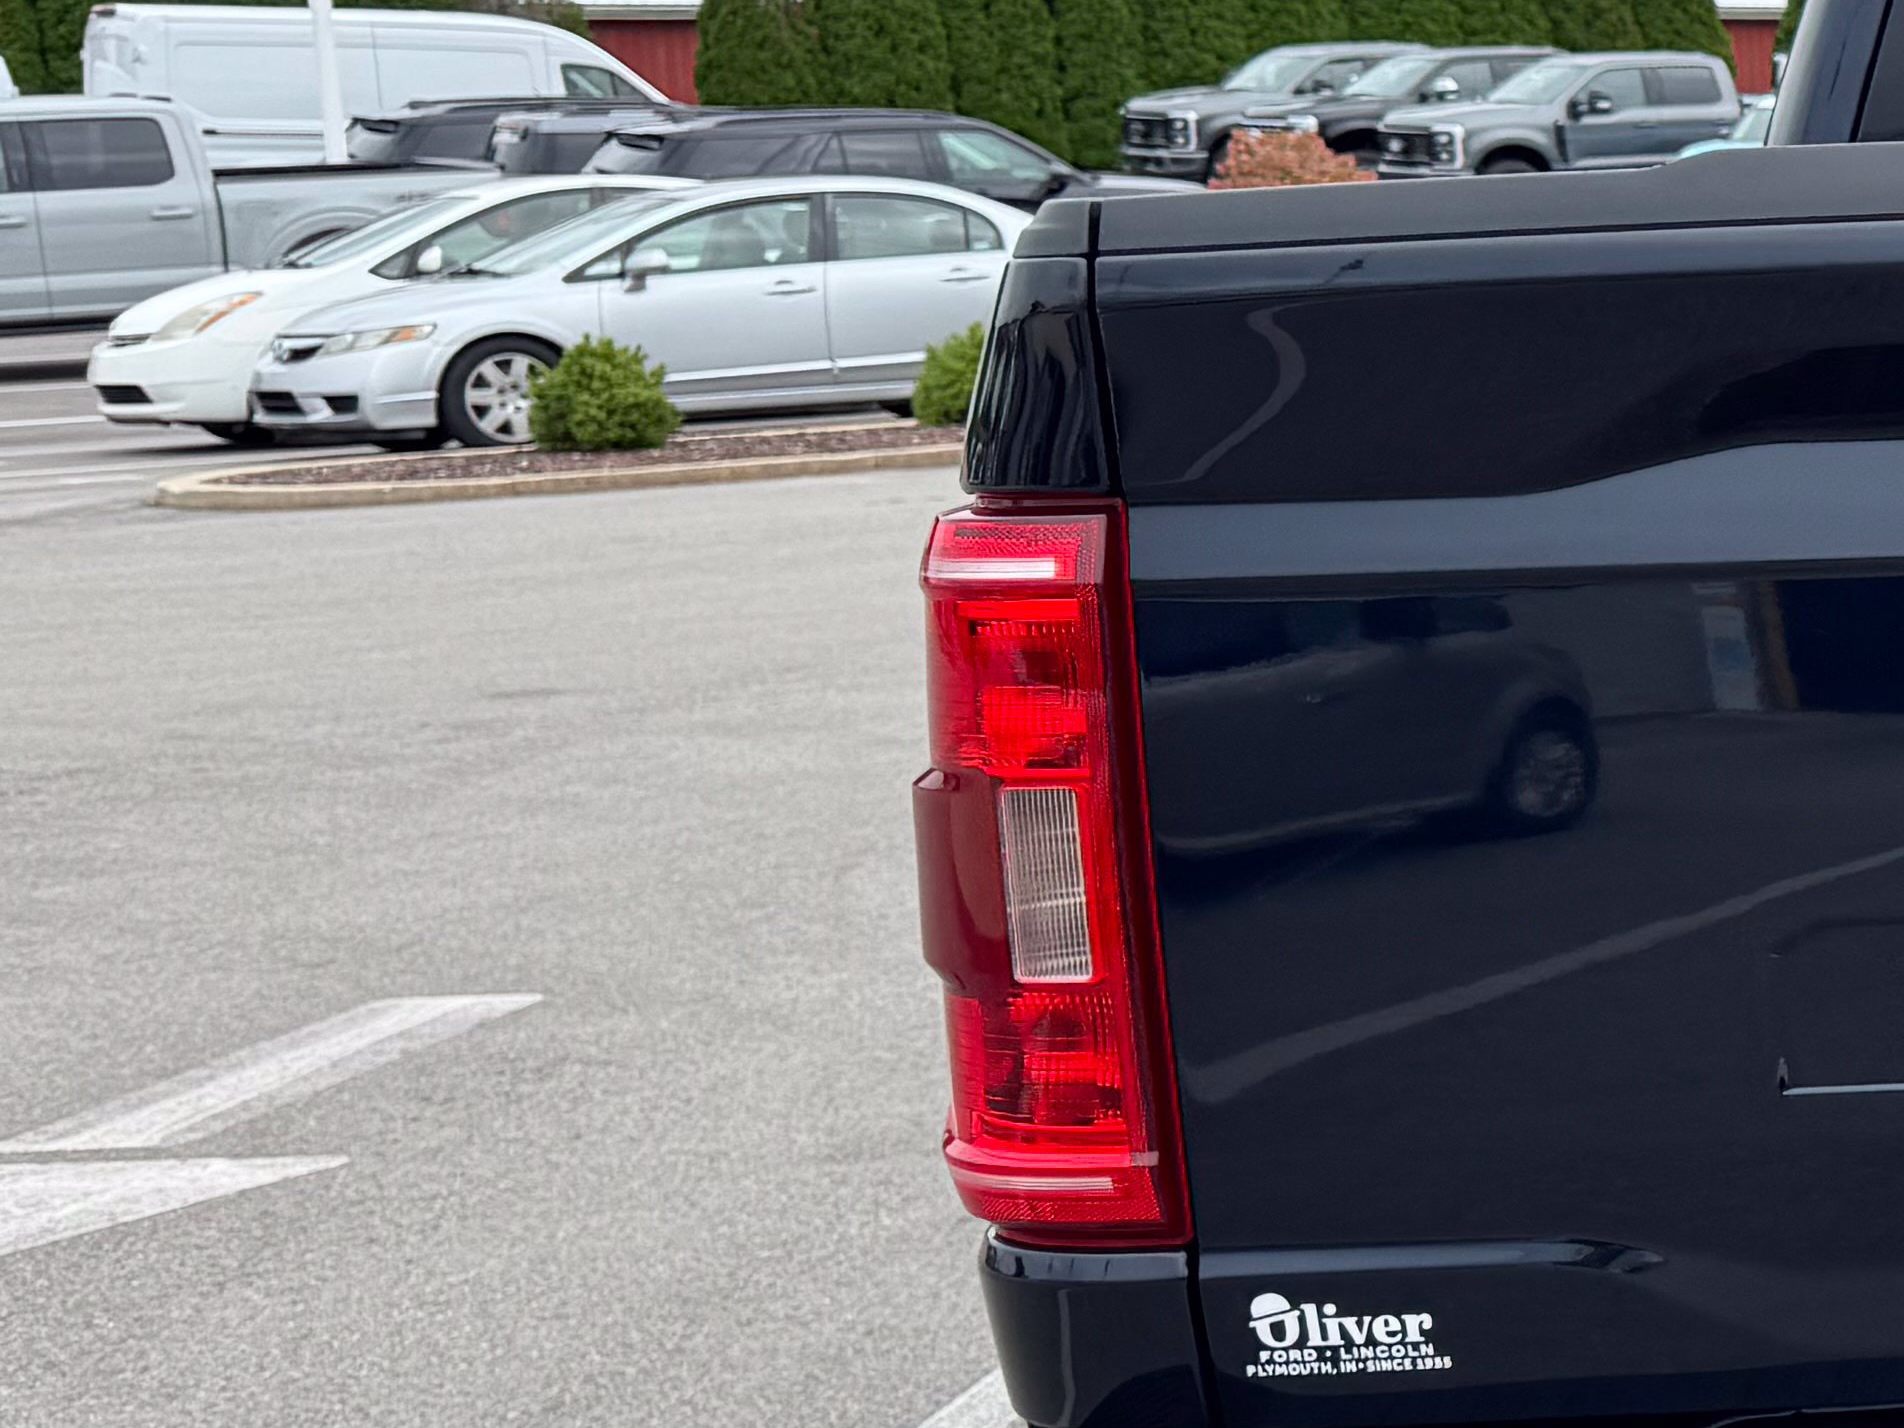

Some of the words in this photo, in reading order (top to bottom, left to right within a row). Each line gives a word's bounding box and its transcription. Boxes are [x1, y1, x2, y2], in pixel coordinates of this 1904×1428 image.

[1249, 1293, 1433, 1348] Oliver
[1259, 1349, 1318, 1363] FORD
[1340, 1343, 1435, 1359] LINCOLN
[1246, 1362, 1337, 1377] PLYMOUTH,
